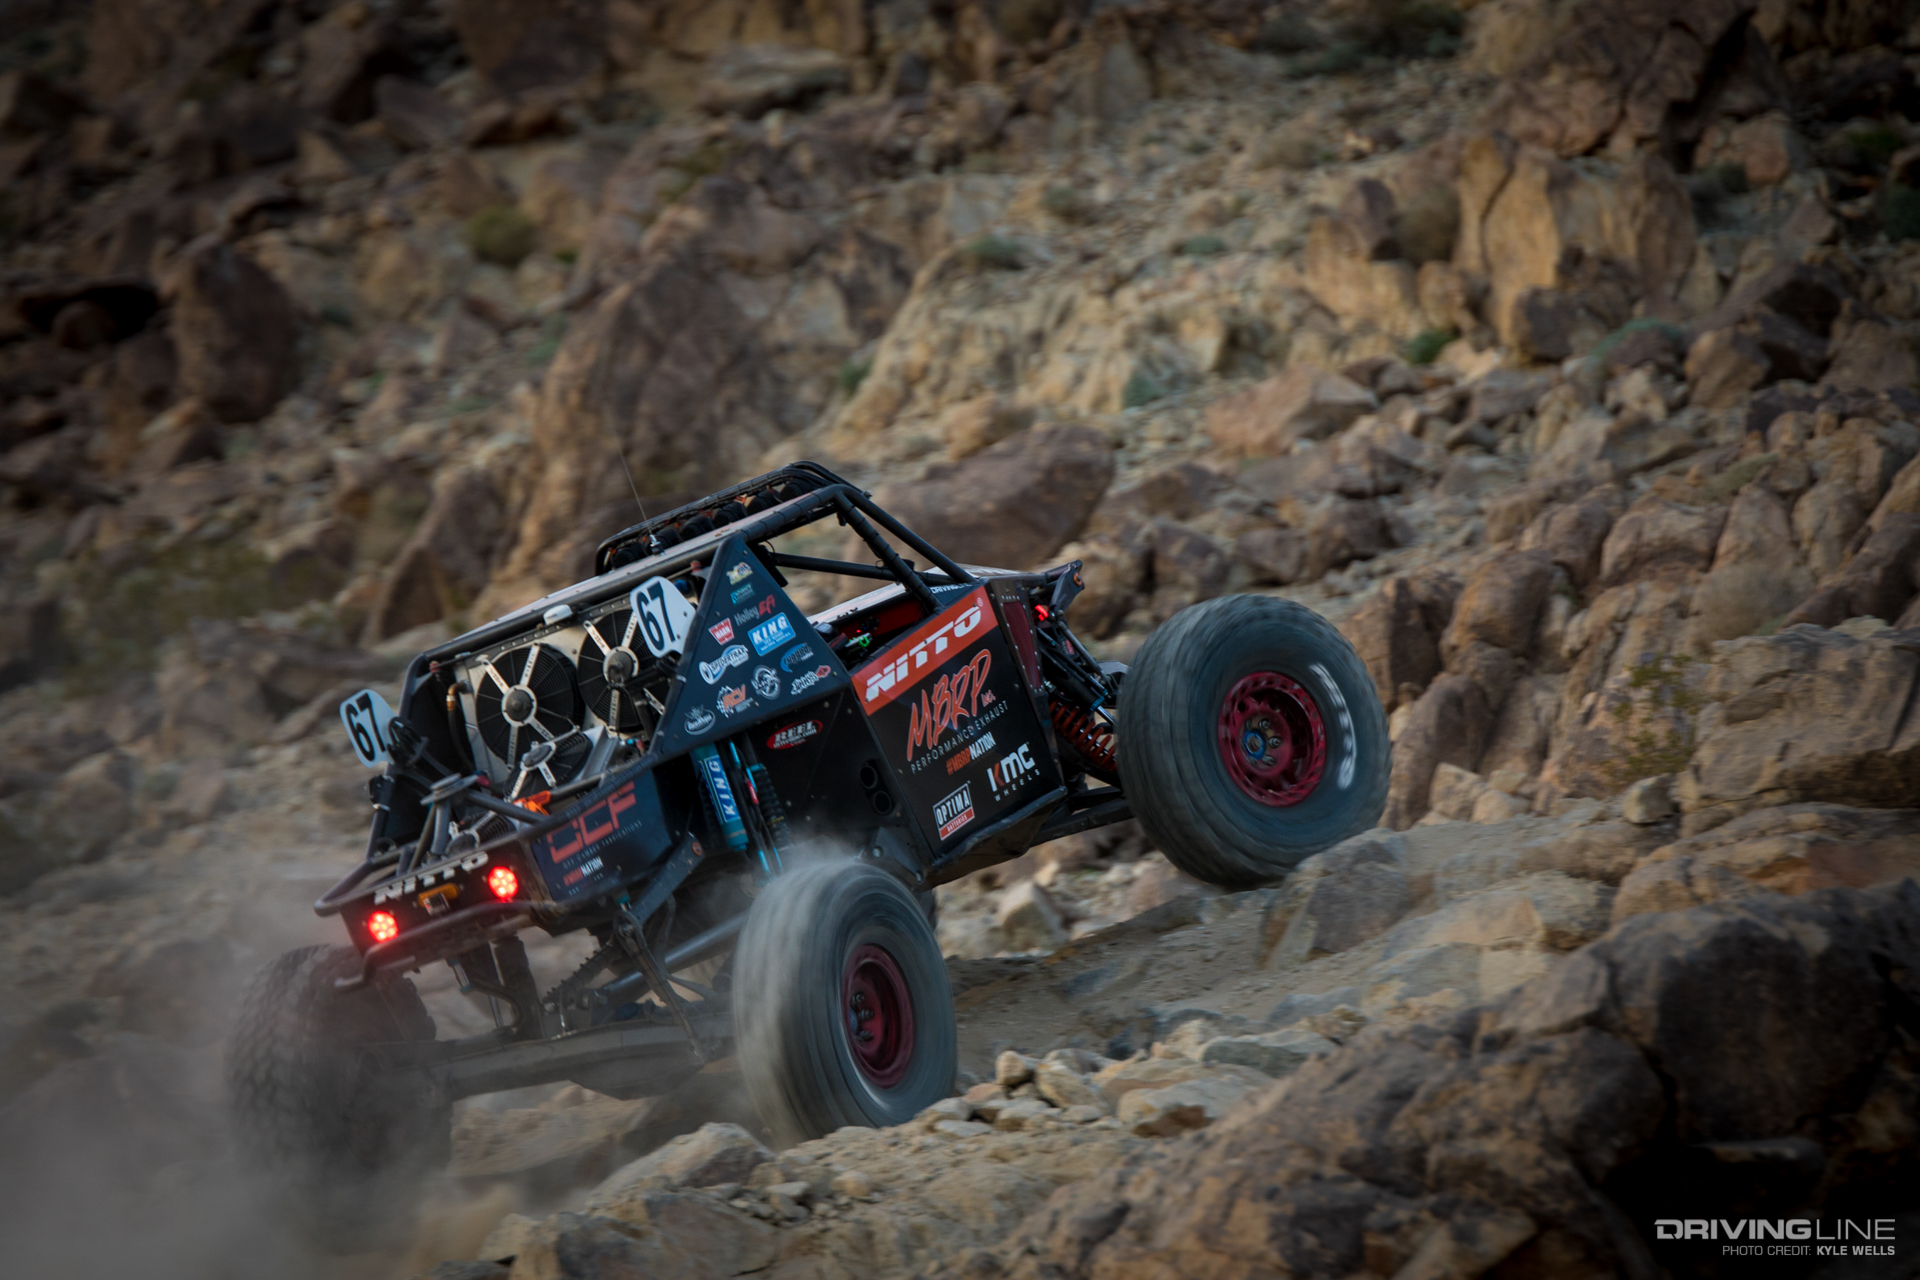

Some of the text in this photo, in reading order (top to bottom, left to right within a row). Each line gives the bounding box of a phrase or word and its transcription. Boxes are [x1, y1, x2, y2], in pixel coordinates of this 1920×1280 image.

[635, 580, 677, 652] 67
[714, 626, 731, 640] WARN
[752, 616, 789, 645] KING
[865, 605, 982, 703] NITTO
[722, 684, 747, 710] RCV
[907, 648, 992, 762] MBRP
[345, 692, 387, 763] 67
[774, 721, 815, 742] REEL
[910, 700, 1009, 775] PERFORMANCE EXHAUST
[946, 731, 997, 776] #MBRPNATION
[709, 760, 736, 816] KING
[935, 789, 971, 825] OPTIMA
[994, 768, 1041, 802] WHEELS
